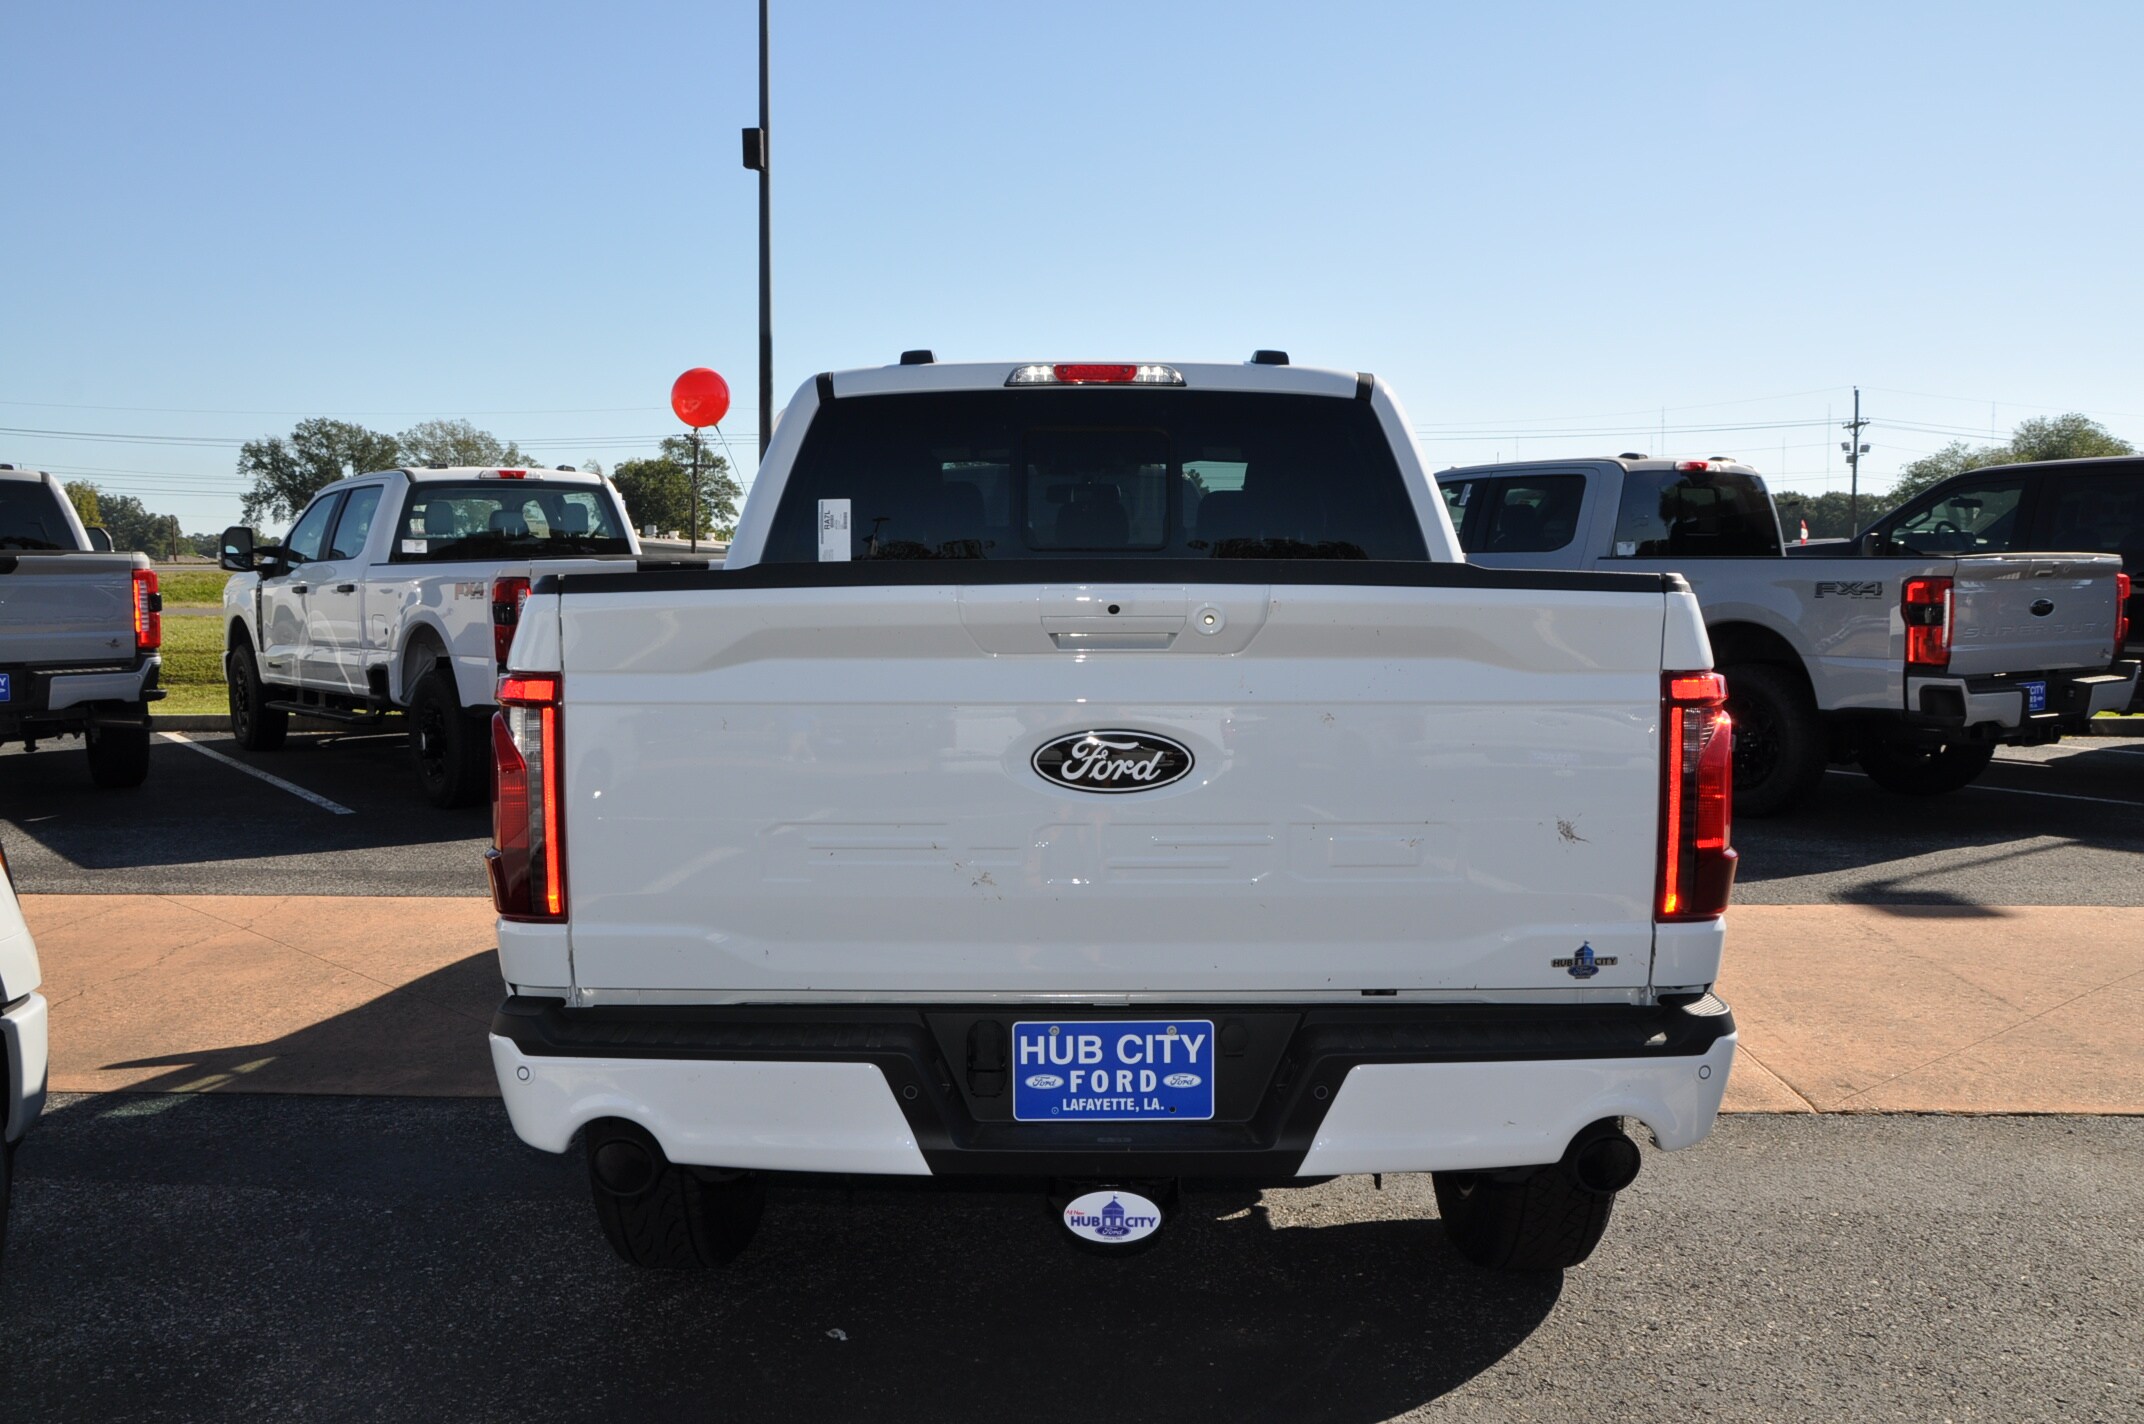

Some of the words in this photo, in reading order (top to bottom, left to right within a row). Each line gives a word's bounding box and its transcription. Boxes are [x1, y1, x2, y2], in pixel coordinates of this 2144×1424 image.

[1814, 581, 1883, 599] FX4
[1963, 624, 2048, 639] SUPER
[2029, 685, 2044, 695] CITY
[1061, 739, 1165, 781] Ford
[1552, 959, 1573, 967] HUB
[1595, 957, 1617, 965] CITY
[1020, 1035, 1103, 1065] HUB
[1116, 1034, 1206, 1064] CITY
[1032, 1076, 1057, 1087] Ford
[1069, 1070, 1157, 1093] FORD
[1170, 1075, 1195, 1086] Ford
[1063, 1098, 1140, 1112] LAFAYETTE,
[1143, 1098, 1165, 1111] LA.
[1070, 1216, 1100, 1227] HUB
[1125, 1217, 1156, 1228] CITY
